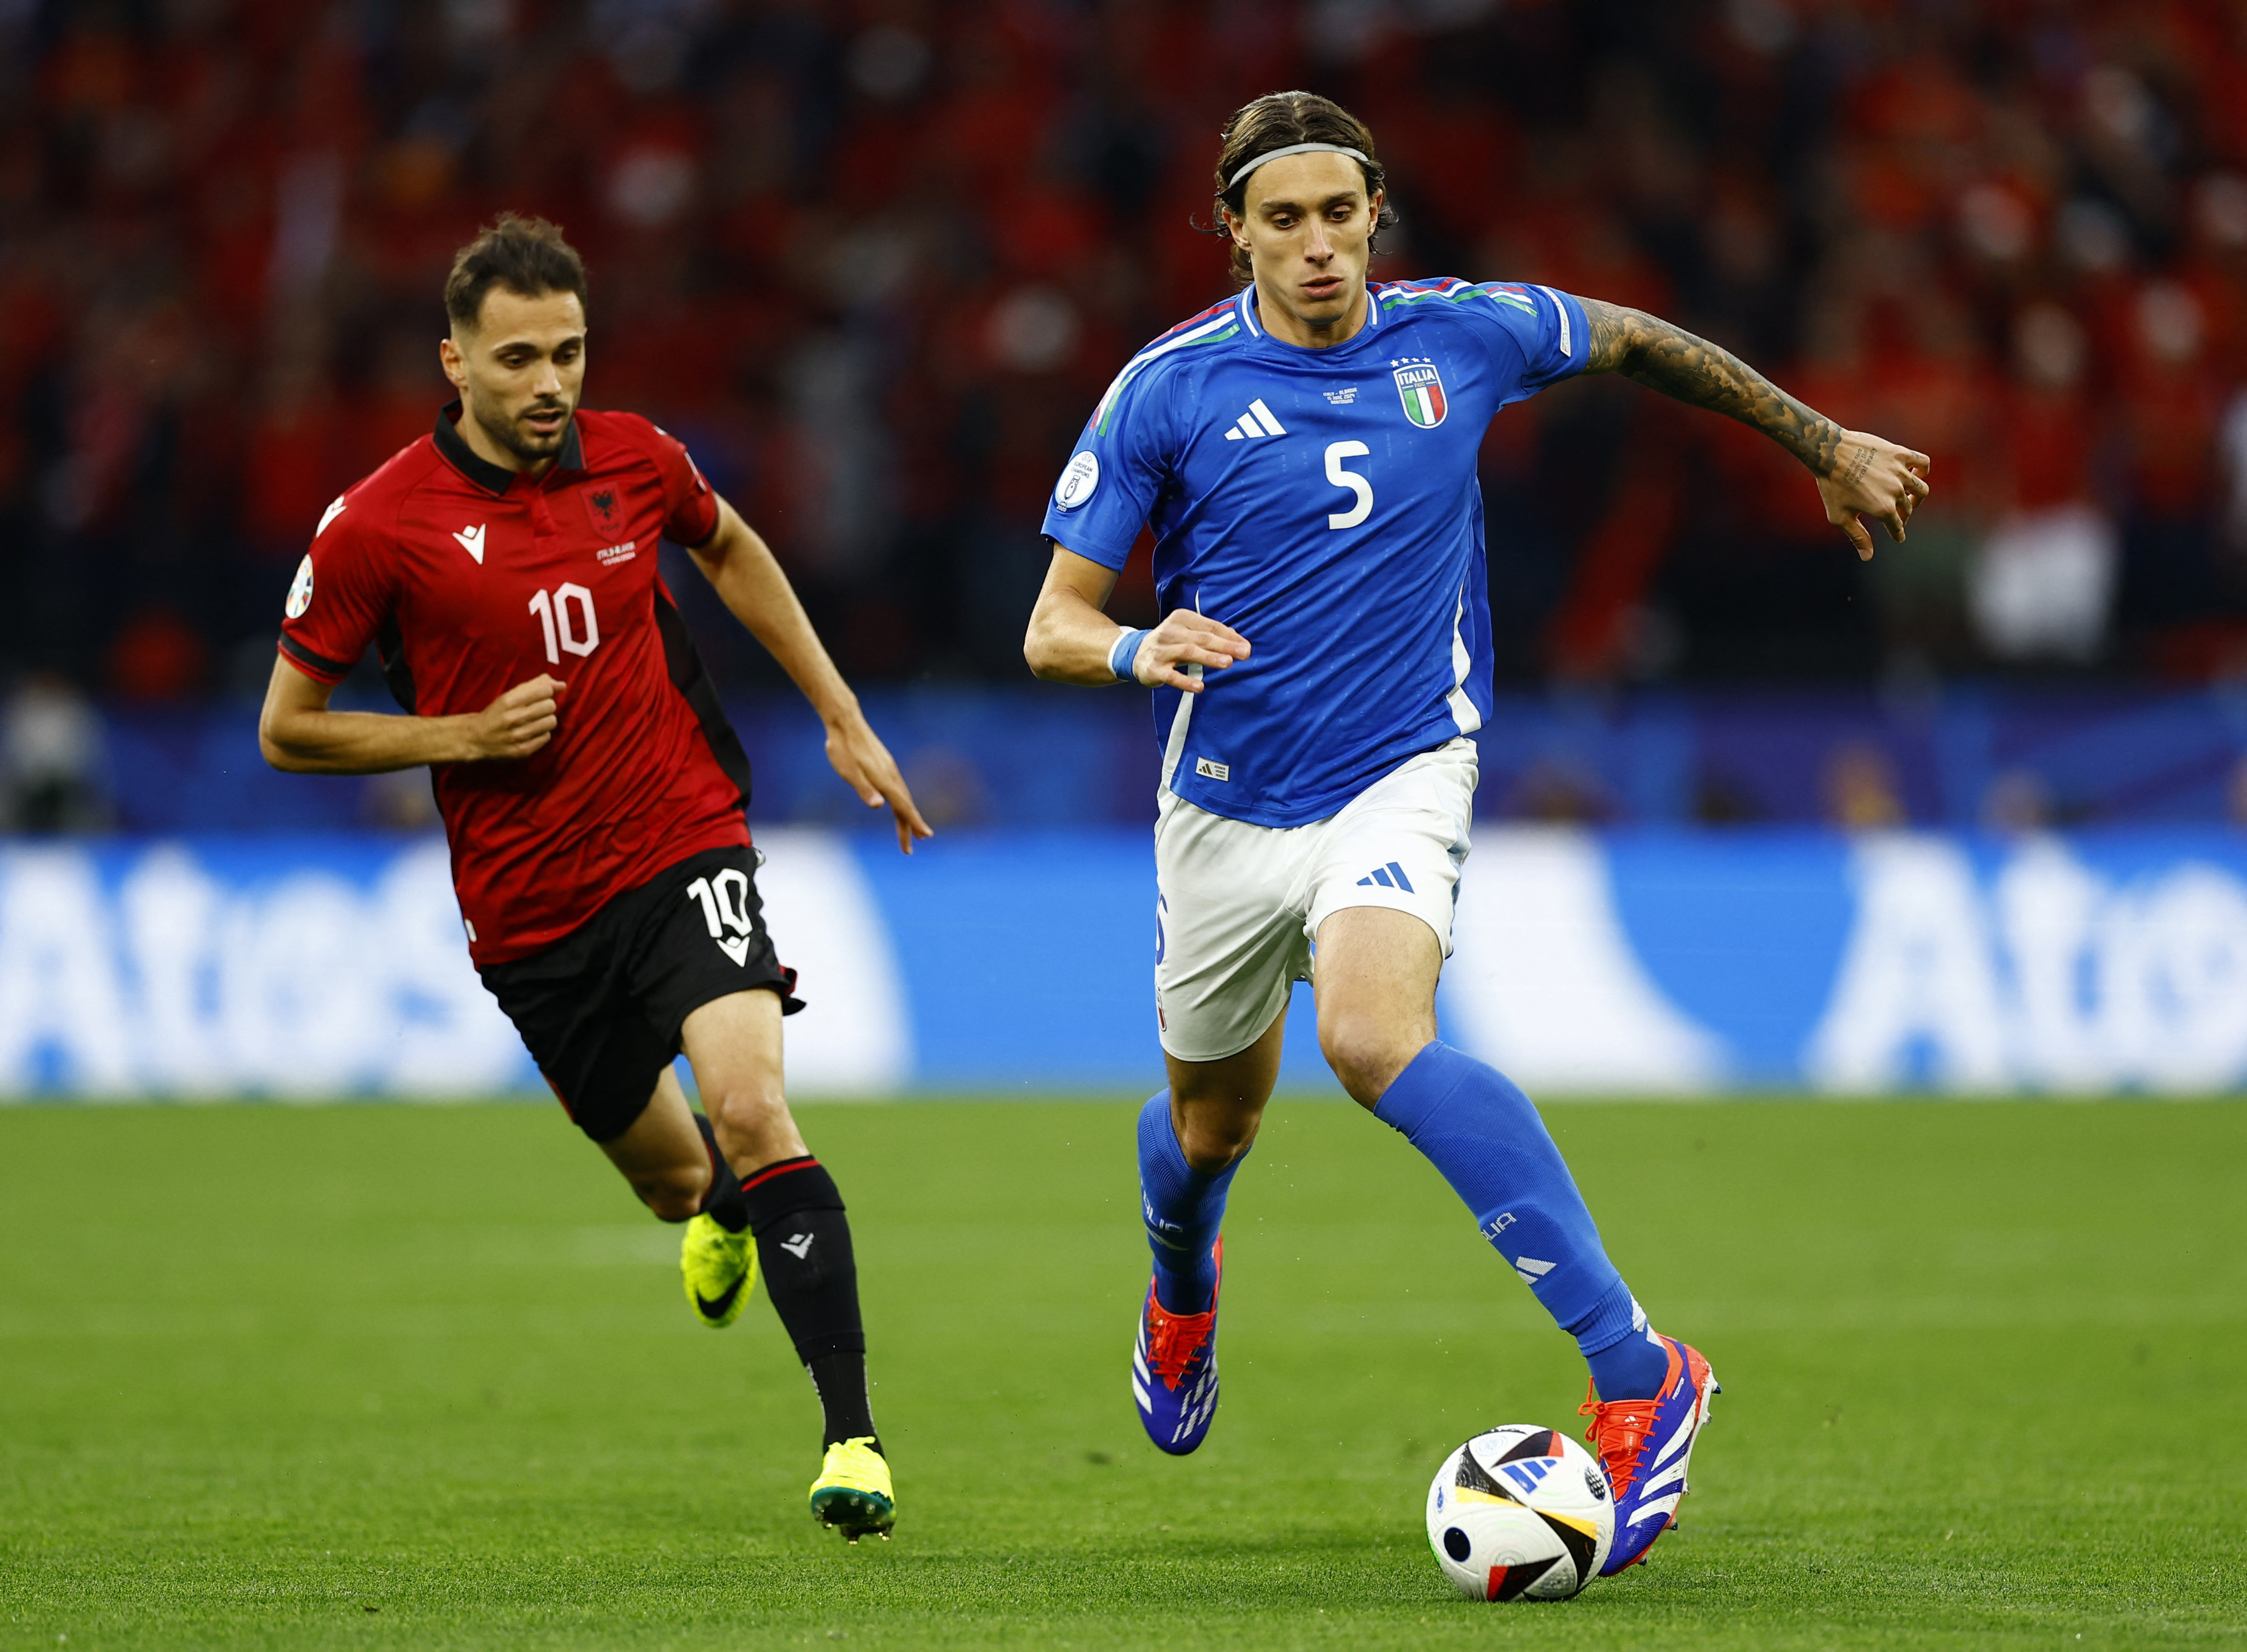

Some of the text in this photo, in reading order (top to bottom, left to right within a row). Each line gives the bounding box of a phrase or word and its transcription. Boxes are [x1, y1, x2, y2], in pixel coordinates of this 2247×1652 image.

[1398, 369, 1436, 385] ITALIA
[1071, 467, 1090, 478] CHAMPIONS
[1074, 461, 1093, 472] EUROPEAN
[1324, 440, 1374, 530] 5
[1056, 504, 1067, 513] 2020
[528, 582, 599, 665] 10
[686, 868, 753, 938] 10
[1672, 1377, 1685, 1400] PREDATOR
